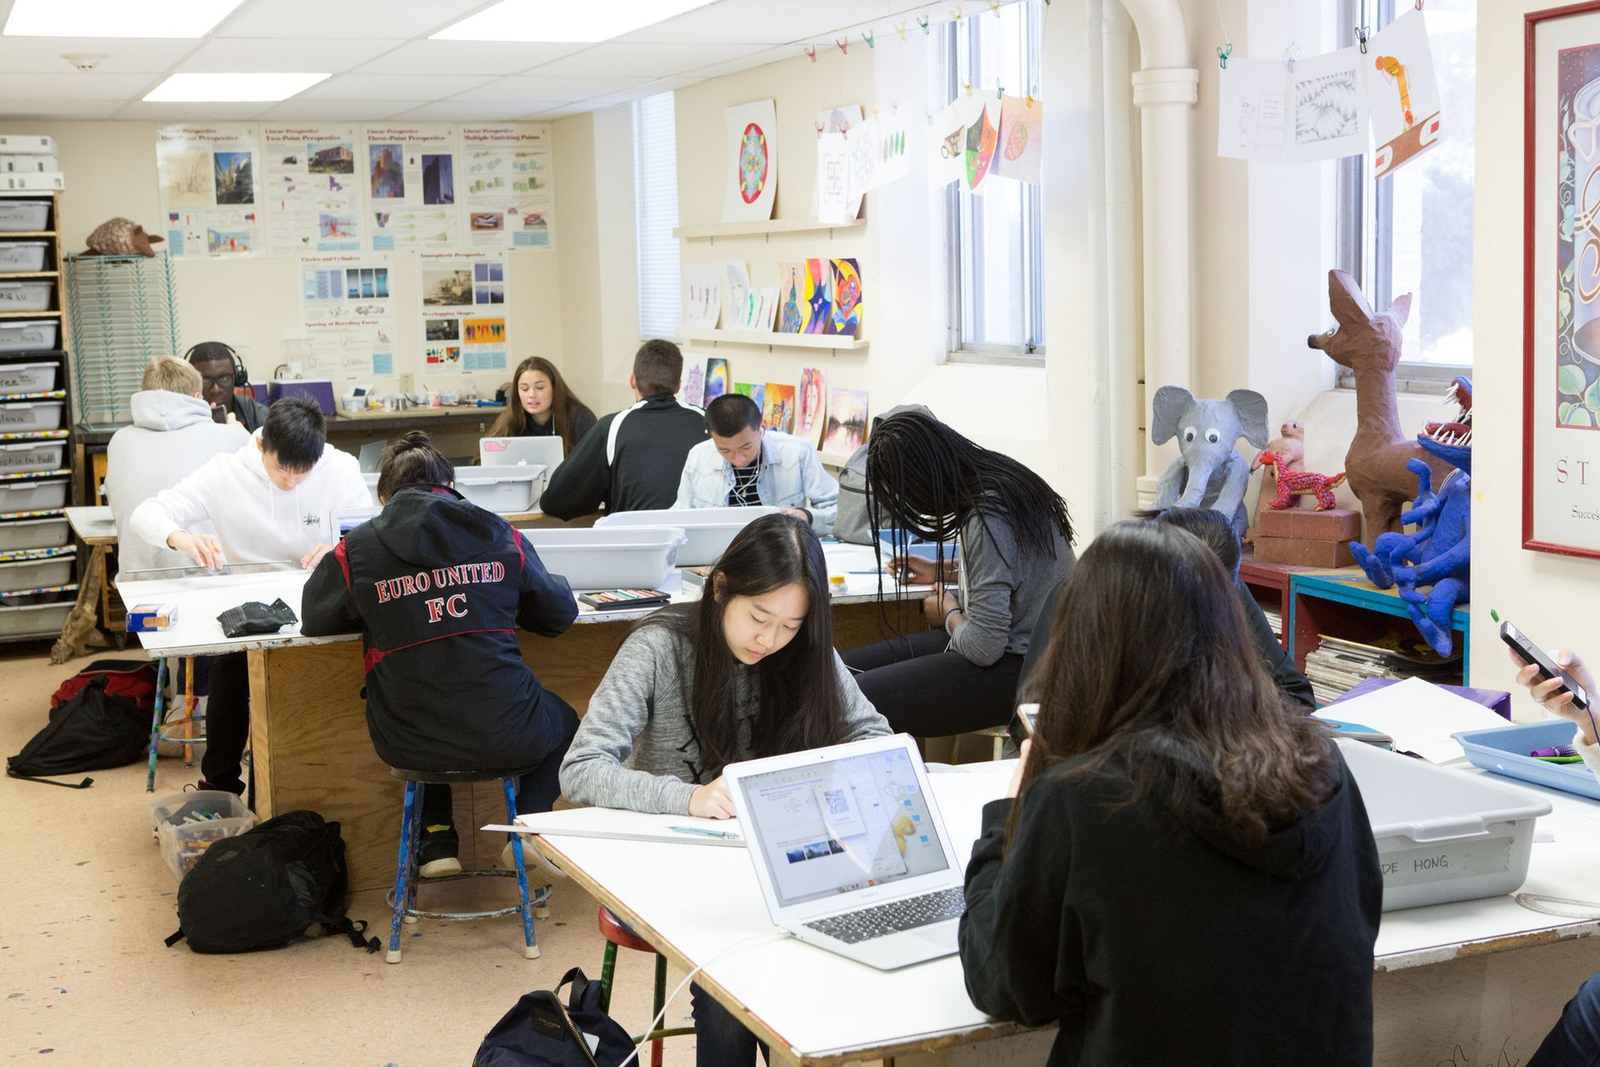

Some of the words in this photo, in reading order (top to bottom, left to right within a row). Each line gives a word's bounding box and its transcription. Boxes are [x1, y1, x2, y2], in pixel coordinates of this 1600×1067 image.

[0, 413, 25, 423] lexa
[1557, 459, 1600, 486] ST
[374, 571, 431, 604] EURO
[432, 561, 505, 589] UNITED
[425, 592, 469, 624] FC
[1414, 854, 1449, 873] HONG
